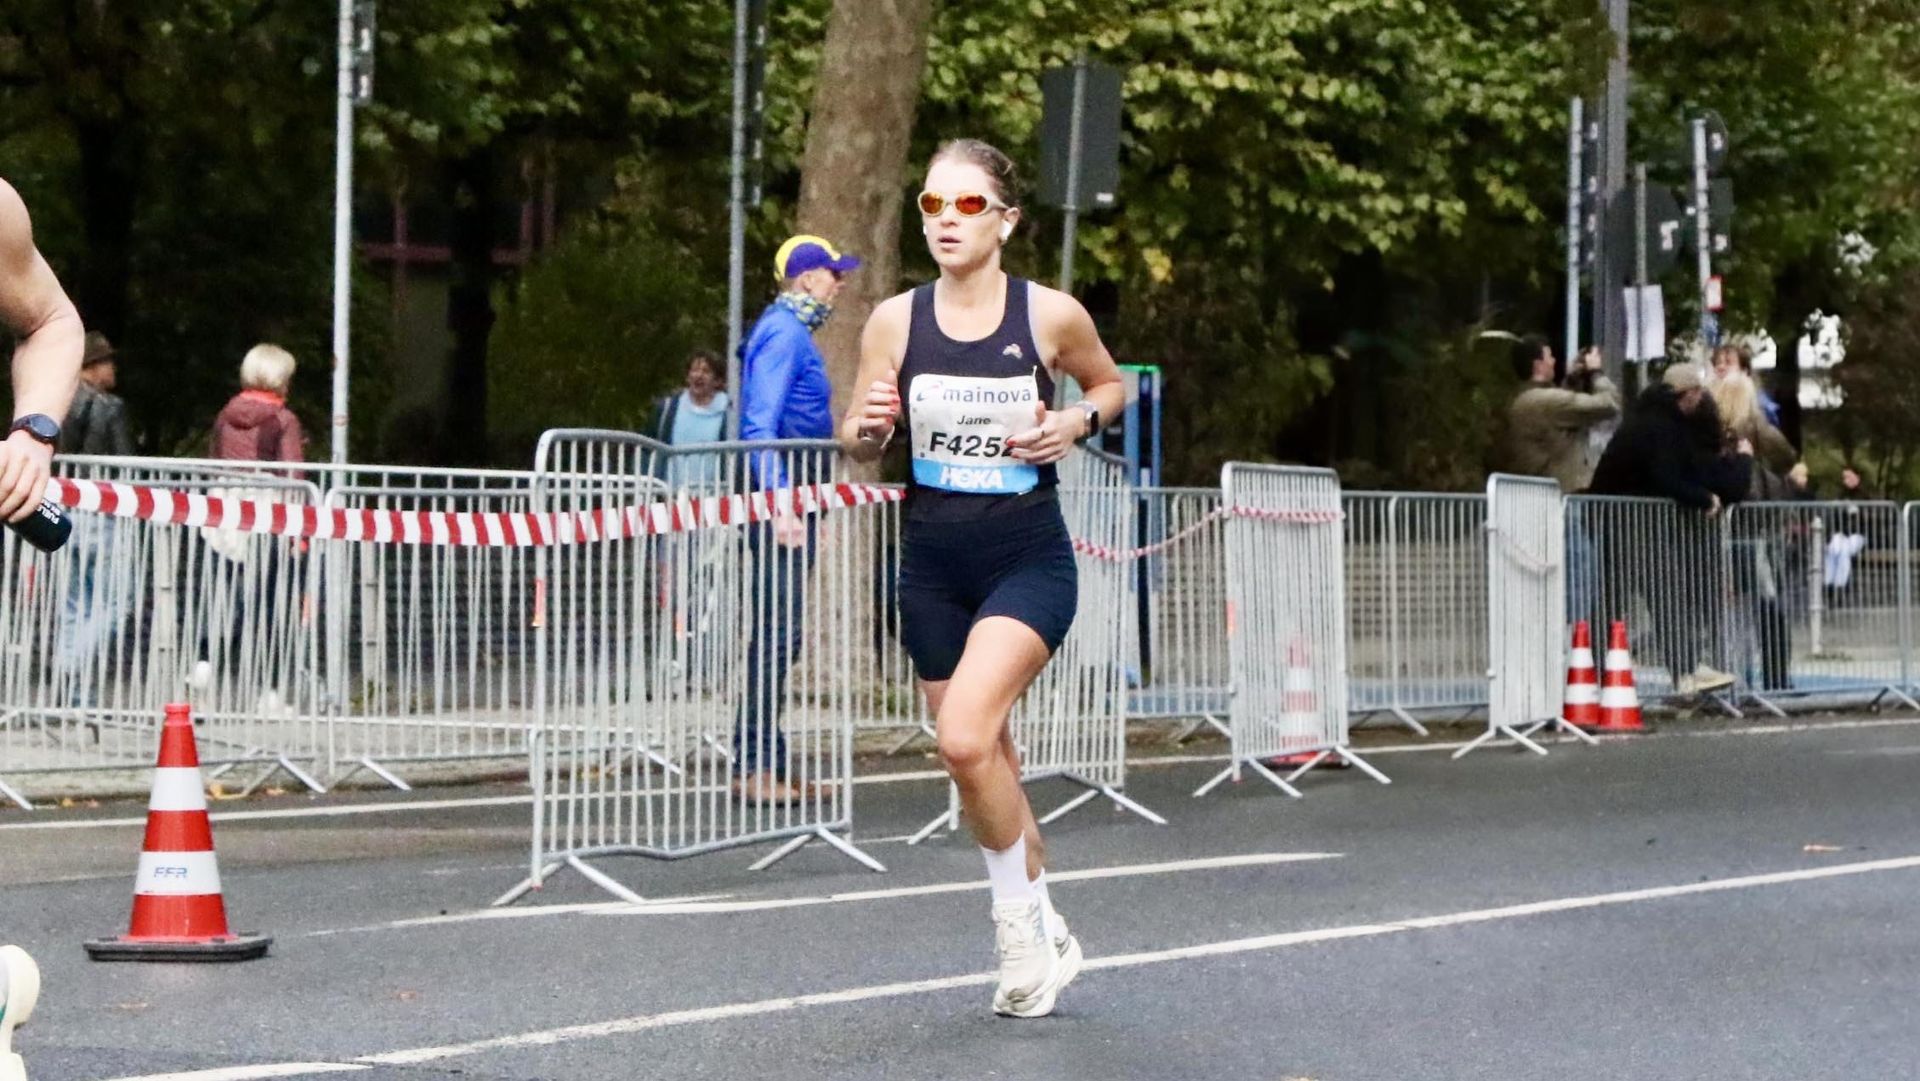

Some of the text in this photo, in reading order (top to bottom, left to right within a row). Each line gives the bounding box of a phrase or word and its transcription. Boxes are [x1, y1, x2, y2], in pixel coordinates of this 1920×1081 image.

[943, 386, 1032, 404] mainova
[956, 415, 991, 426] Jane
[940, 465, 1004, 489] HOKA
